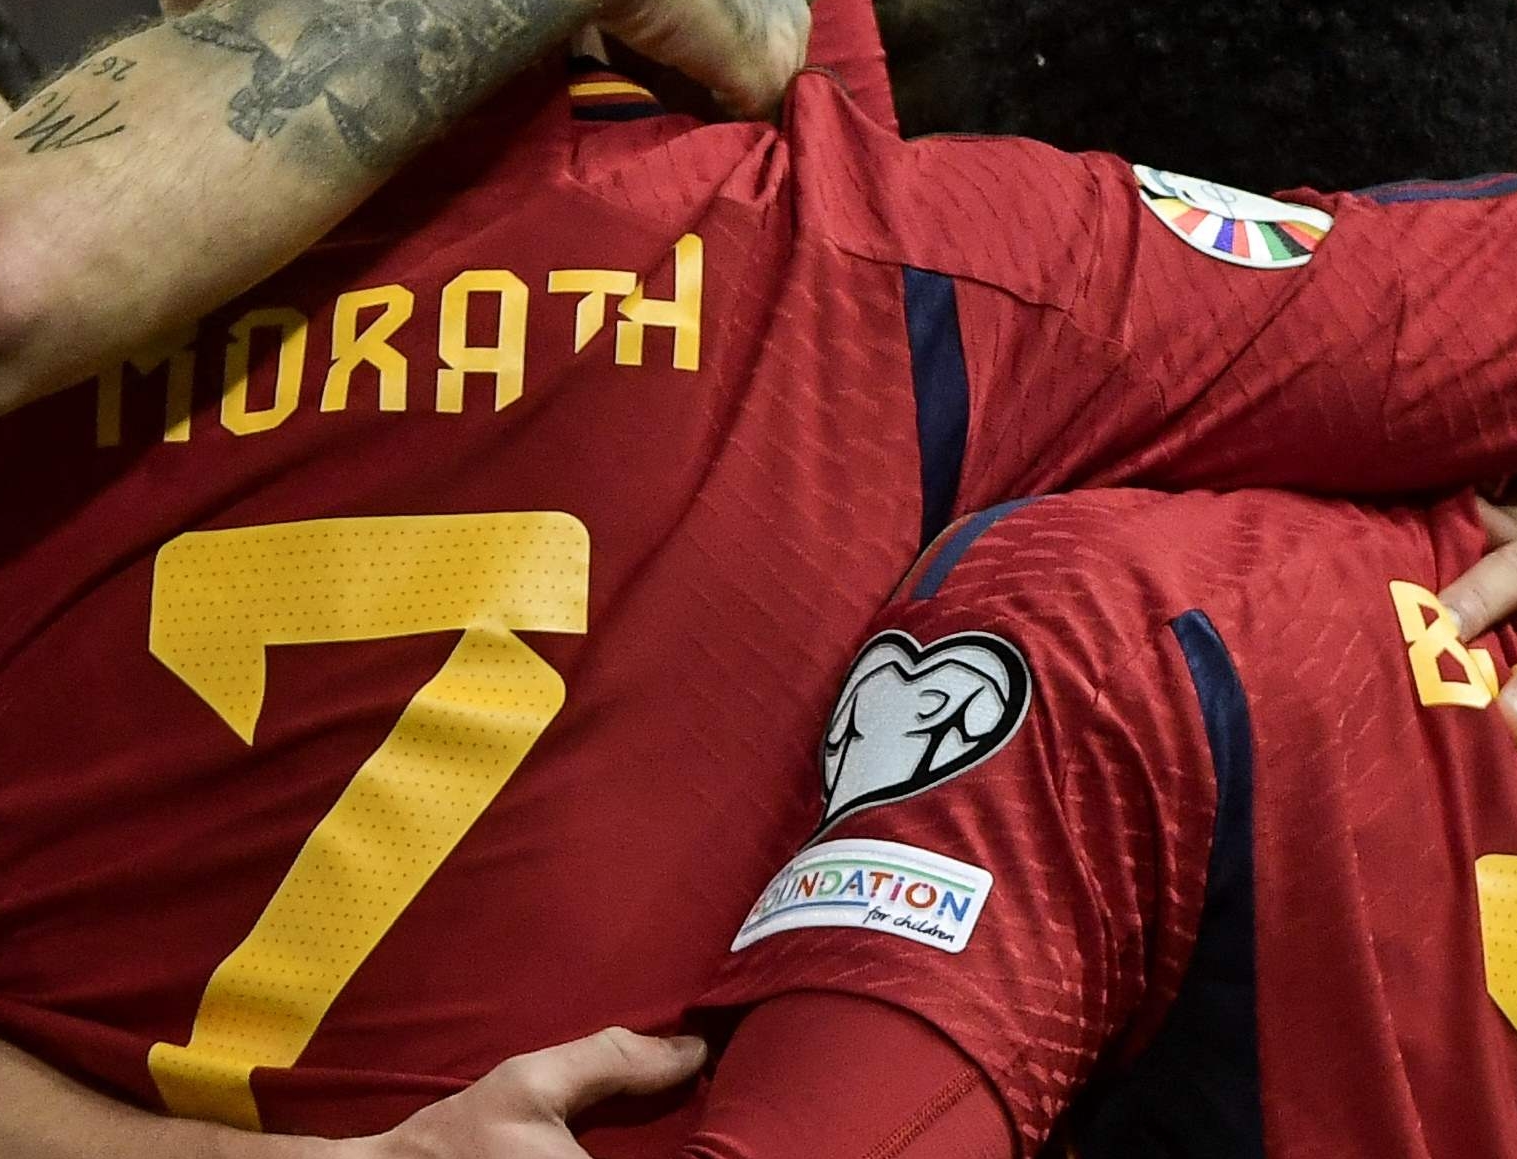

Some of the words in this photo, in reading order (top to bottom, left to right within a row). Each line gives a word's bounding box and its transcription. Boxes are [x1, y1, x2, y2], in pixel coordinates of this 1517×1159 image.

[147, 510, 592, 1132] 7
[862, 905, 888, 925] for
[892, 913, 956, 943] children
